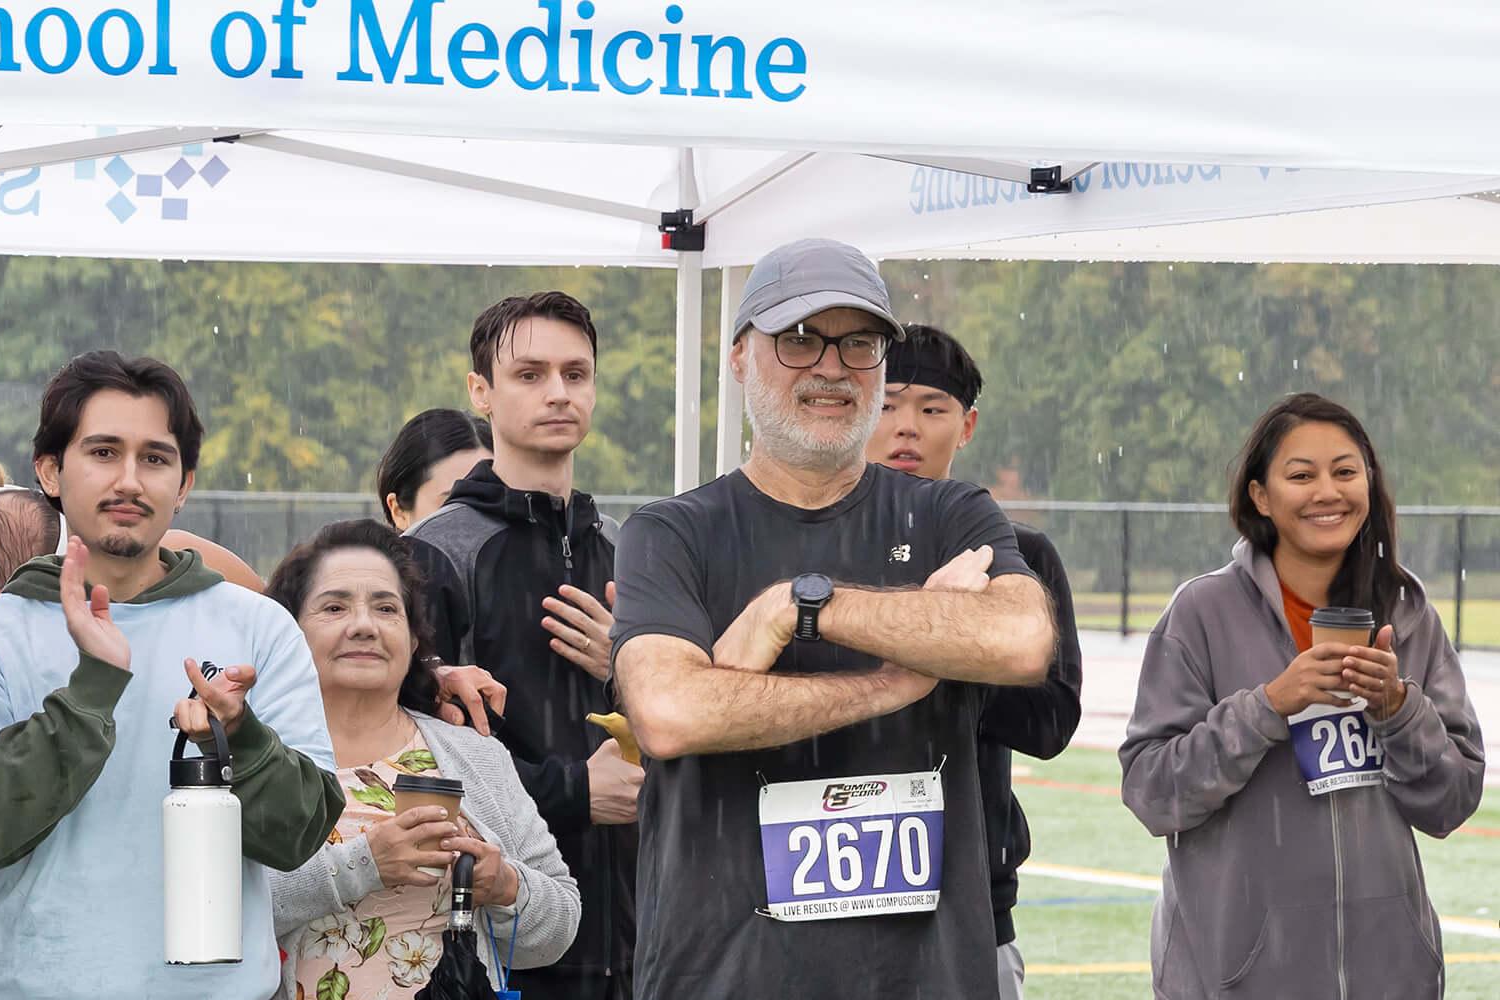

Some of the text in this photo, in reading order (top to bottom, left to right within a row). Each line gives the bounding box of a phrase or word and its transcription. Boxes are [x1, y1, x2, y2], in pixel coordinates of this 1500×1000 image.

[209, 0, 318, 80] of
[336, 0, 808, 103] Medicine
[787, 816, 932, 896] 2670
[783, 905, 801, 917] LIVE
[803, 902, 839, 915] RESULTS
[839, 900, 850, 913] @
